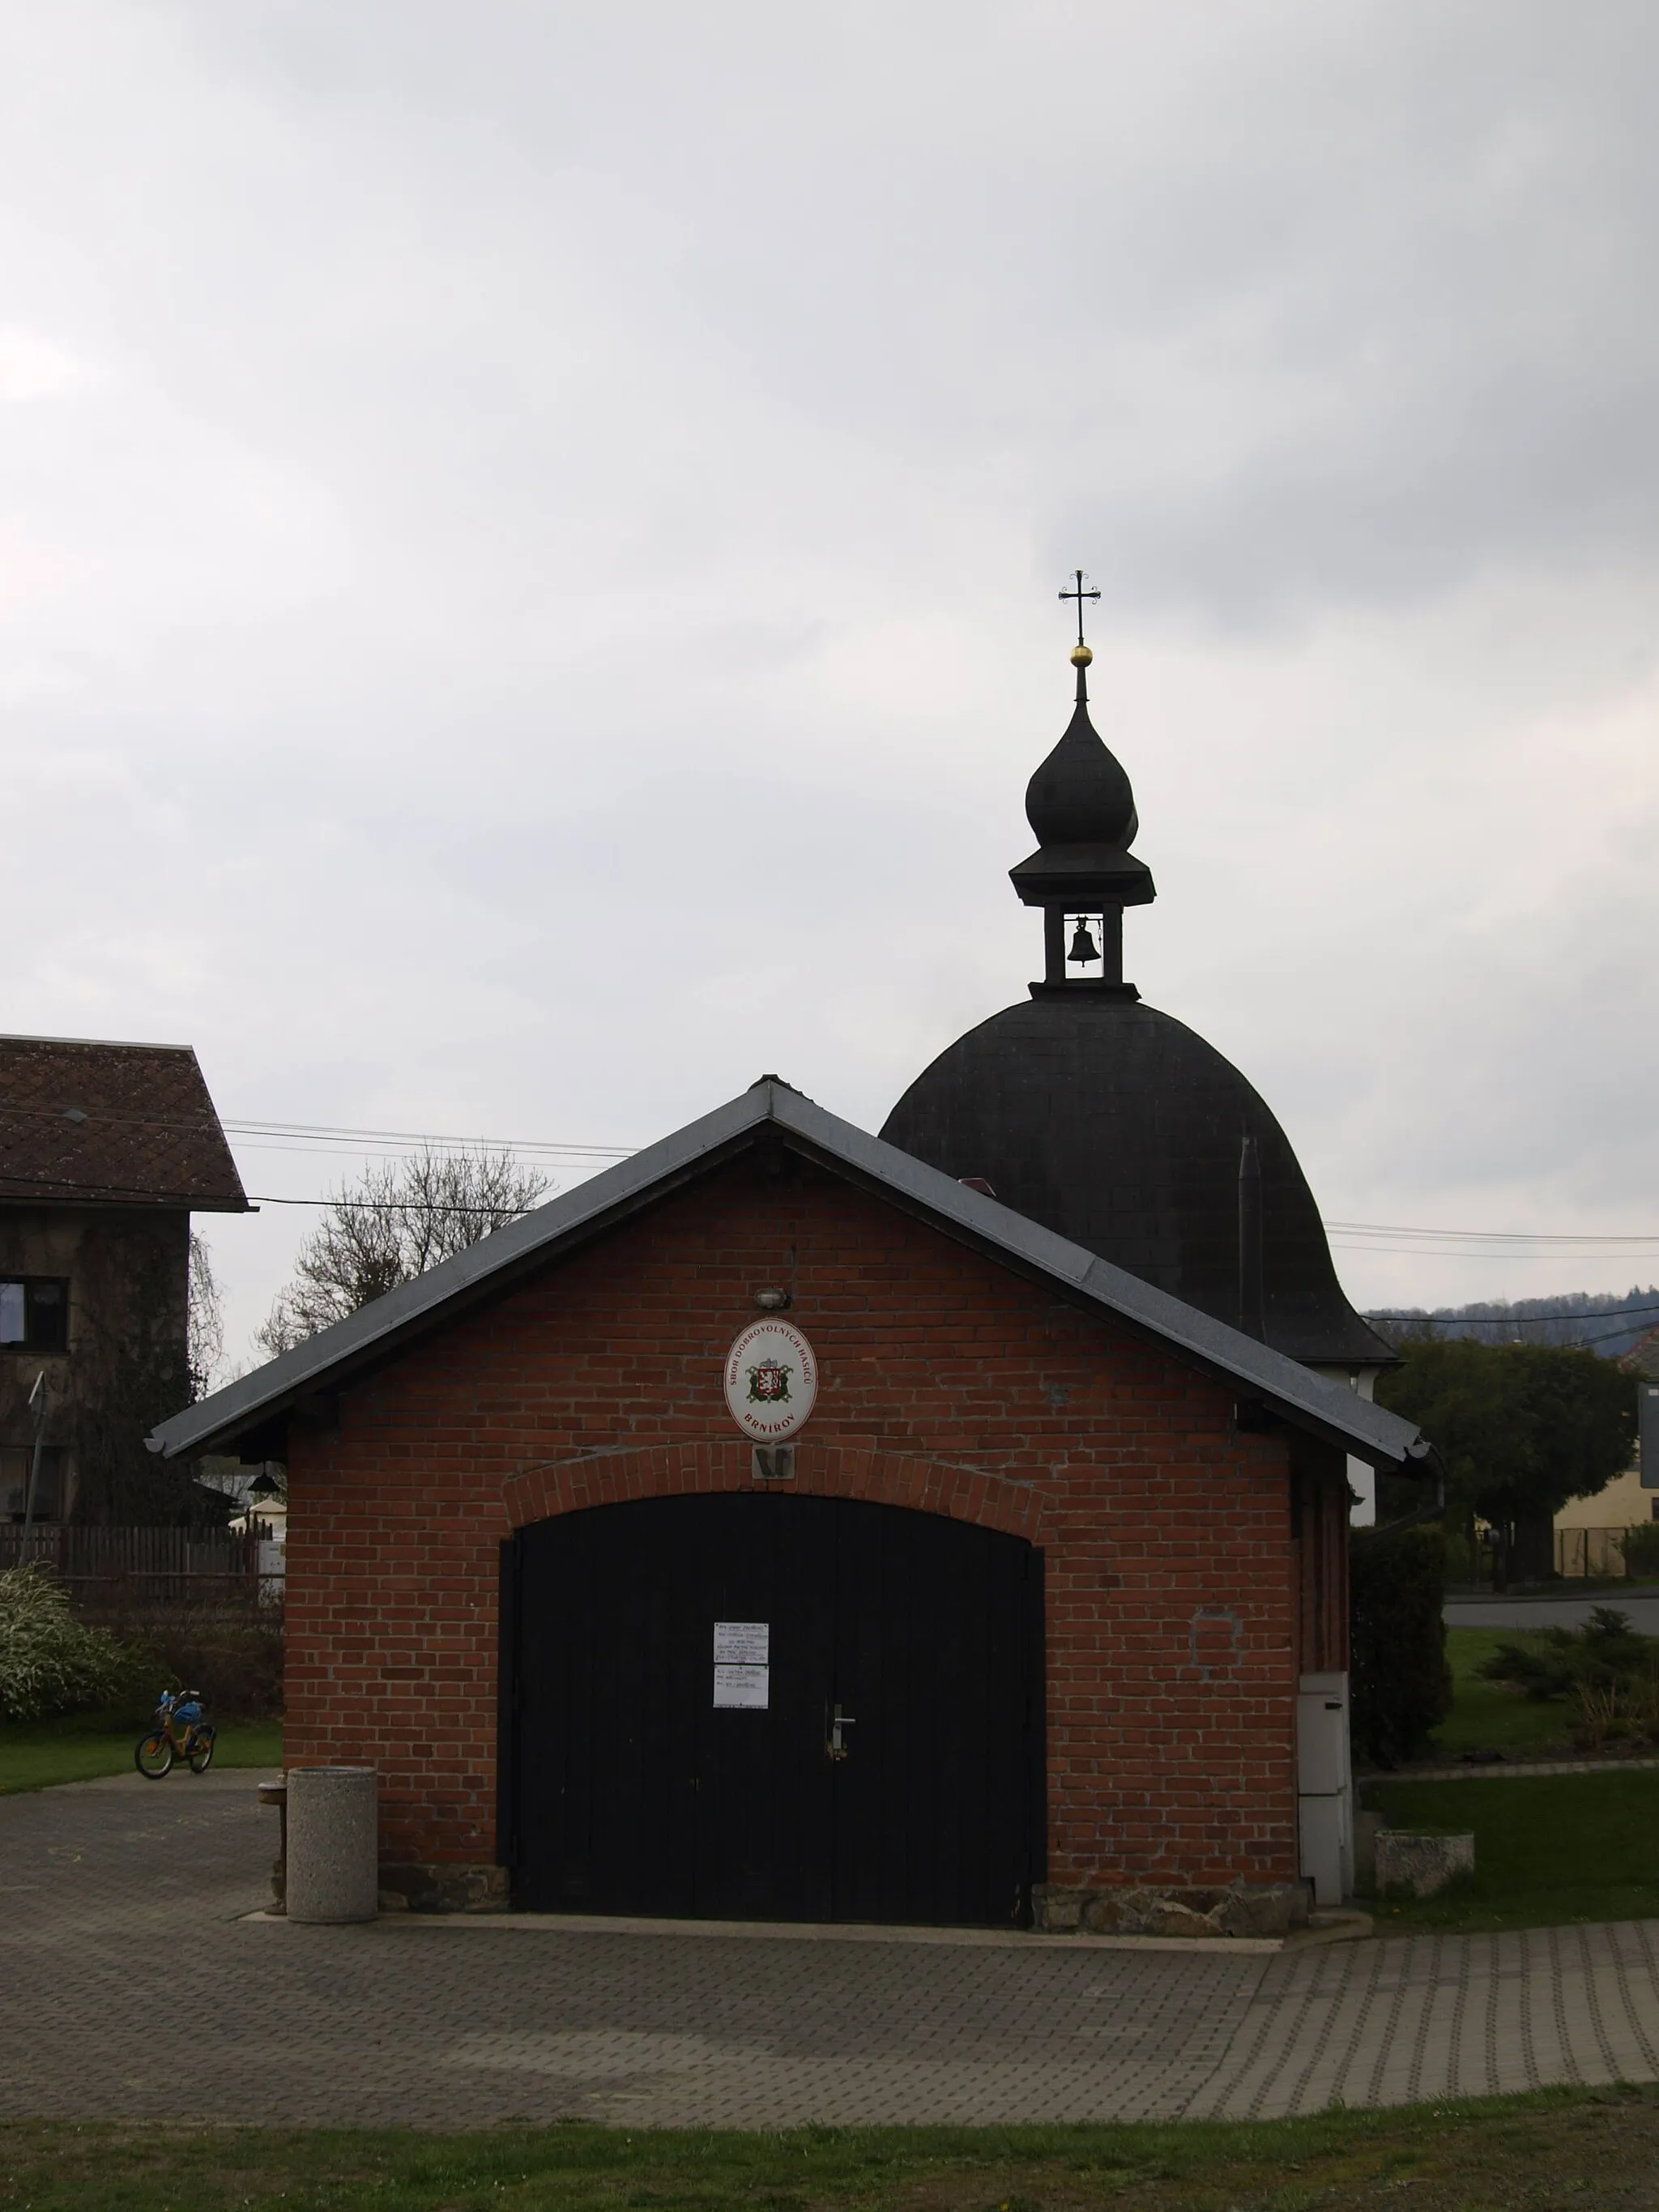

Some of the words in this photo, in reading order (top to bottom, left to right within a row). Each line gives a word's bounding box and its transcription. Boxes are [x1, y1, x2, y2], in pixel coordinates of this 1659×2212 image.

[730, 1360, 739, 1386] SBOR
[736, 1325, 801, 1358] DOBROVOLNÝCH
[798, 1349, 813, 1385] HASIČŮ
[744, 1413, 795, 1433] BRNÍŘOV
